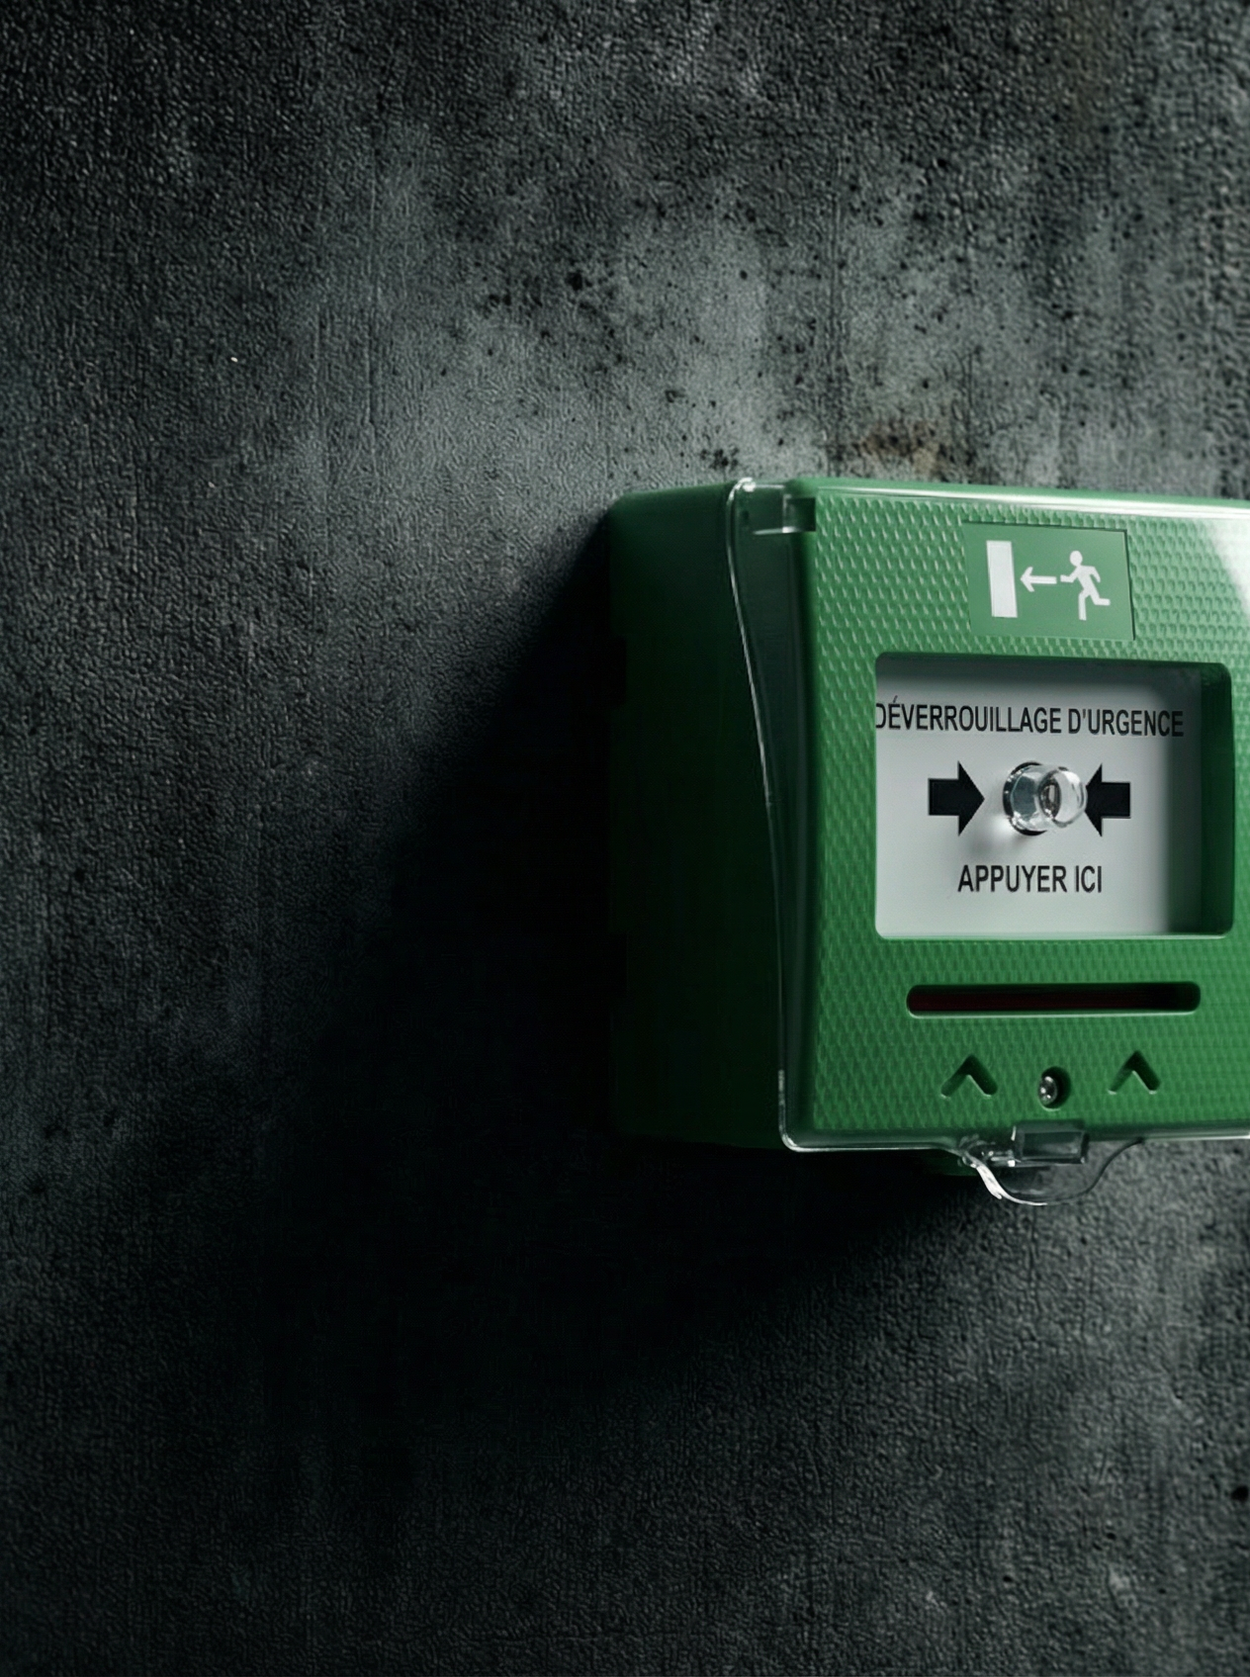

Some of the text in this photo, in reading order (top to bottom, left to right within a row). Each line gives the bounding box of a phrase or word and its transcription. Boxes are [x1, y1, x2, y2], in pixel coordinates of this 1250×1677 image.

[875, 695, 1184, 737] DÉVERROUILLAGE D'URGENCE
[957, 864, 1102, 893] APPUYER ICI
